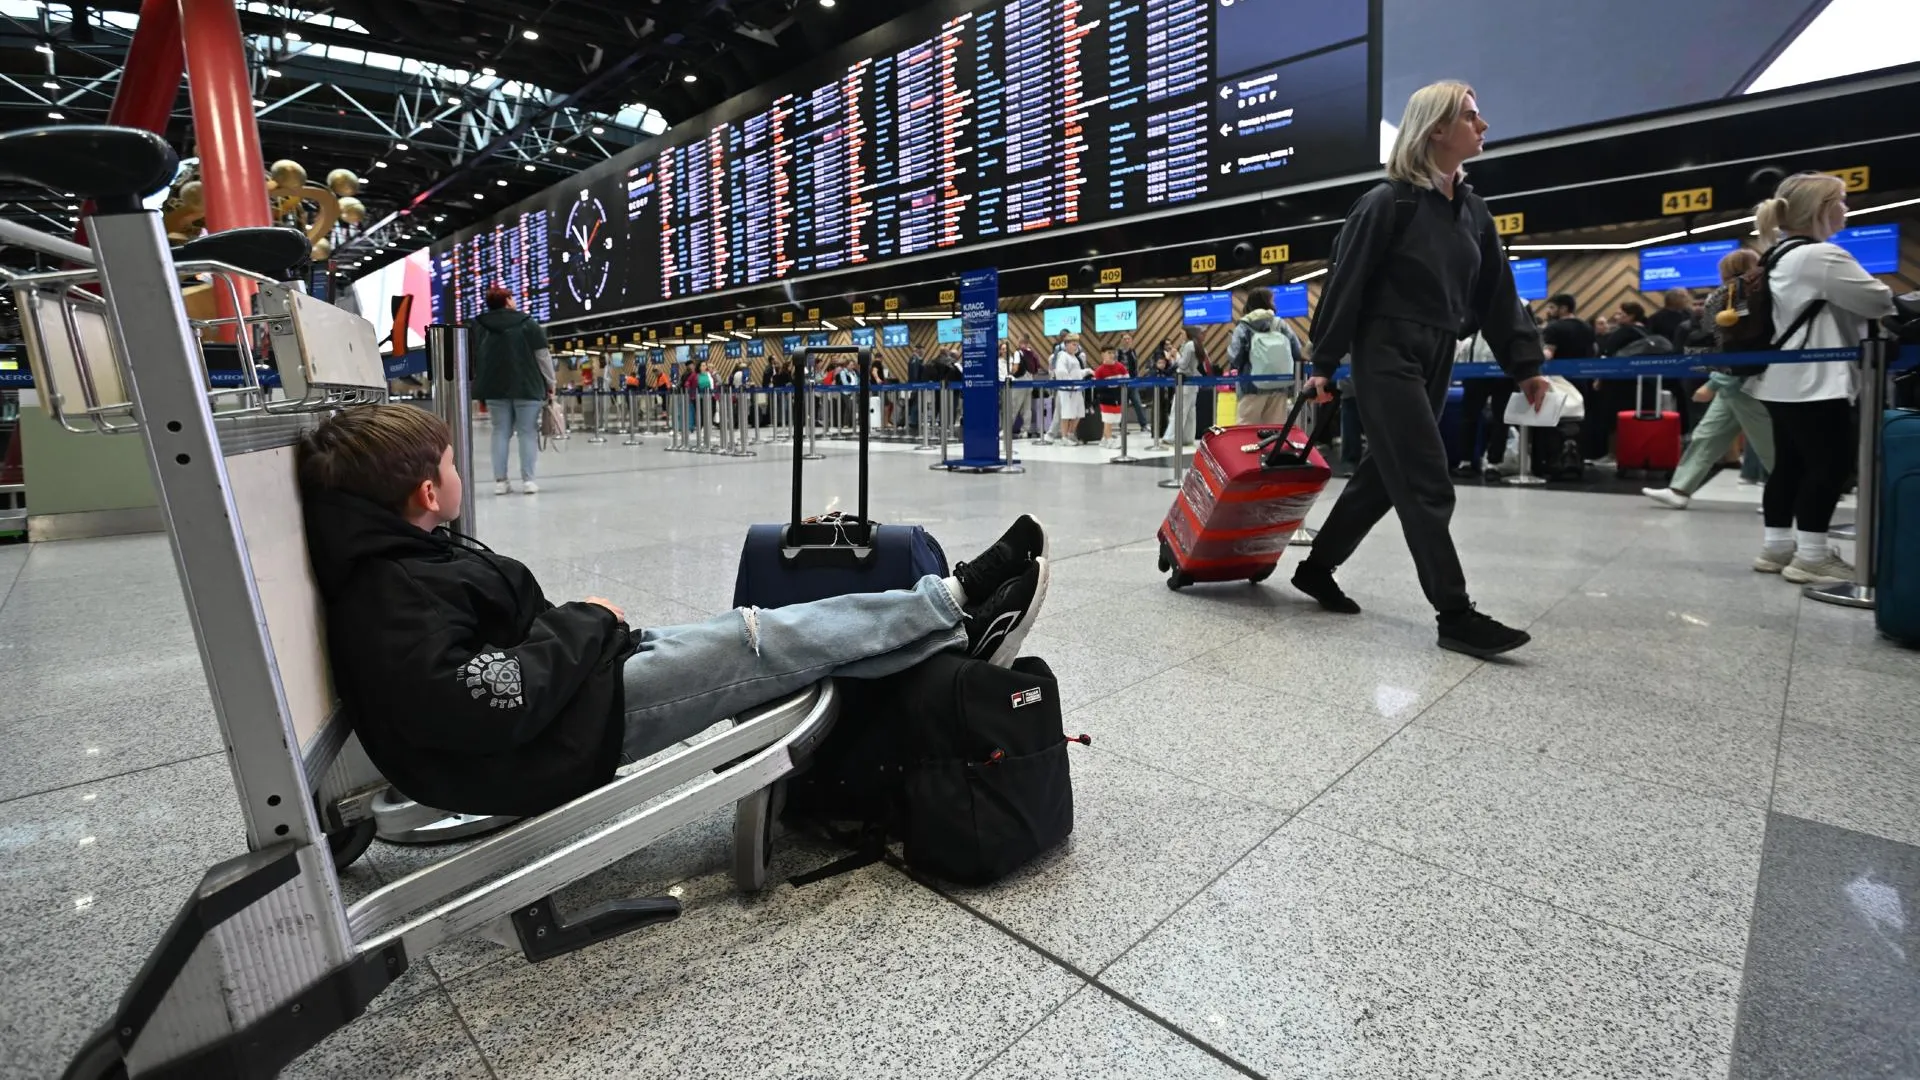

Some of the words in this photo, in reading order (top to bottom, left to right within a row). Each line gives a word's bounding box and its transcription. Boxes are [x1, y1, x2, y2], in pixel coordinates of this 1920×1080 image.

[1666, 192, 1708, 209] 414
[1263, 248, 1286, 260] 411
[1193, 258, 1215, 270] 410
[1102, 270, 1120, 280] 409
[1050, 277, 1067, 287] 408
[963, 302, 984, 311] КЛАСС
[963, 309, 990, 319] ЭКОНОМ
[489, 695, 523, 709] STAY
